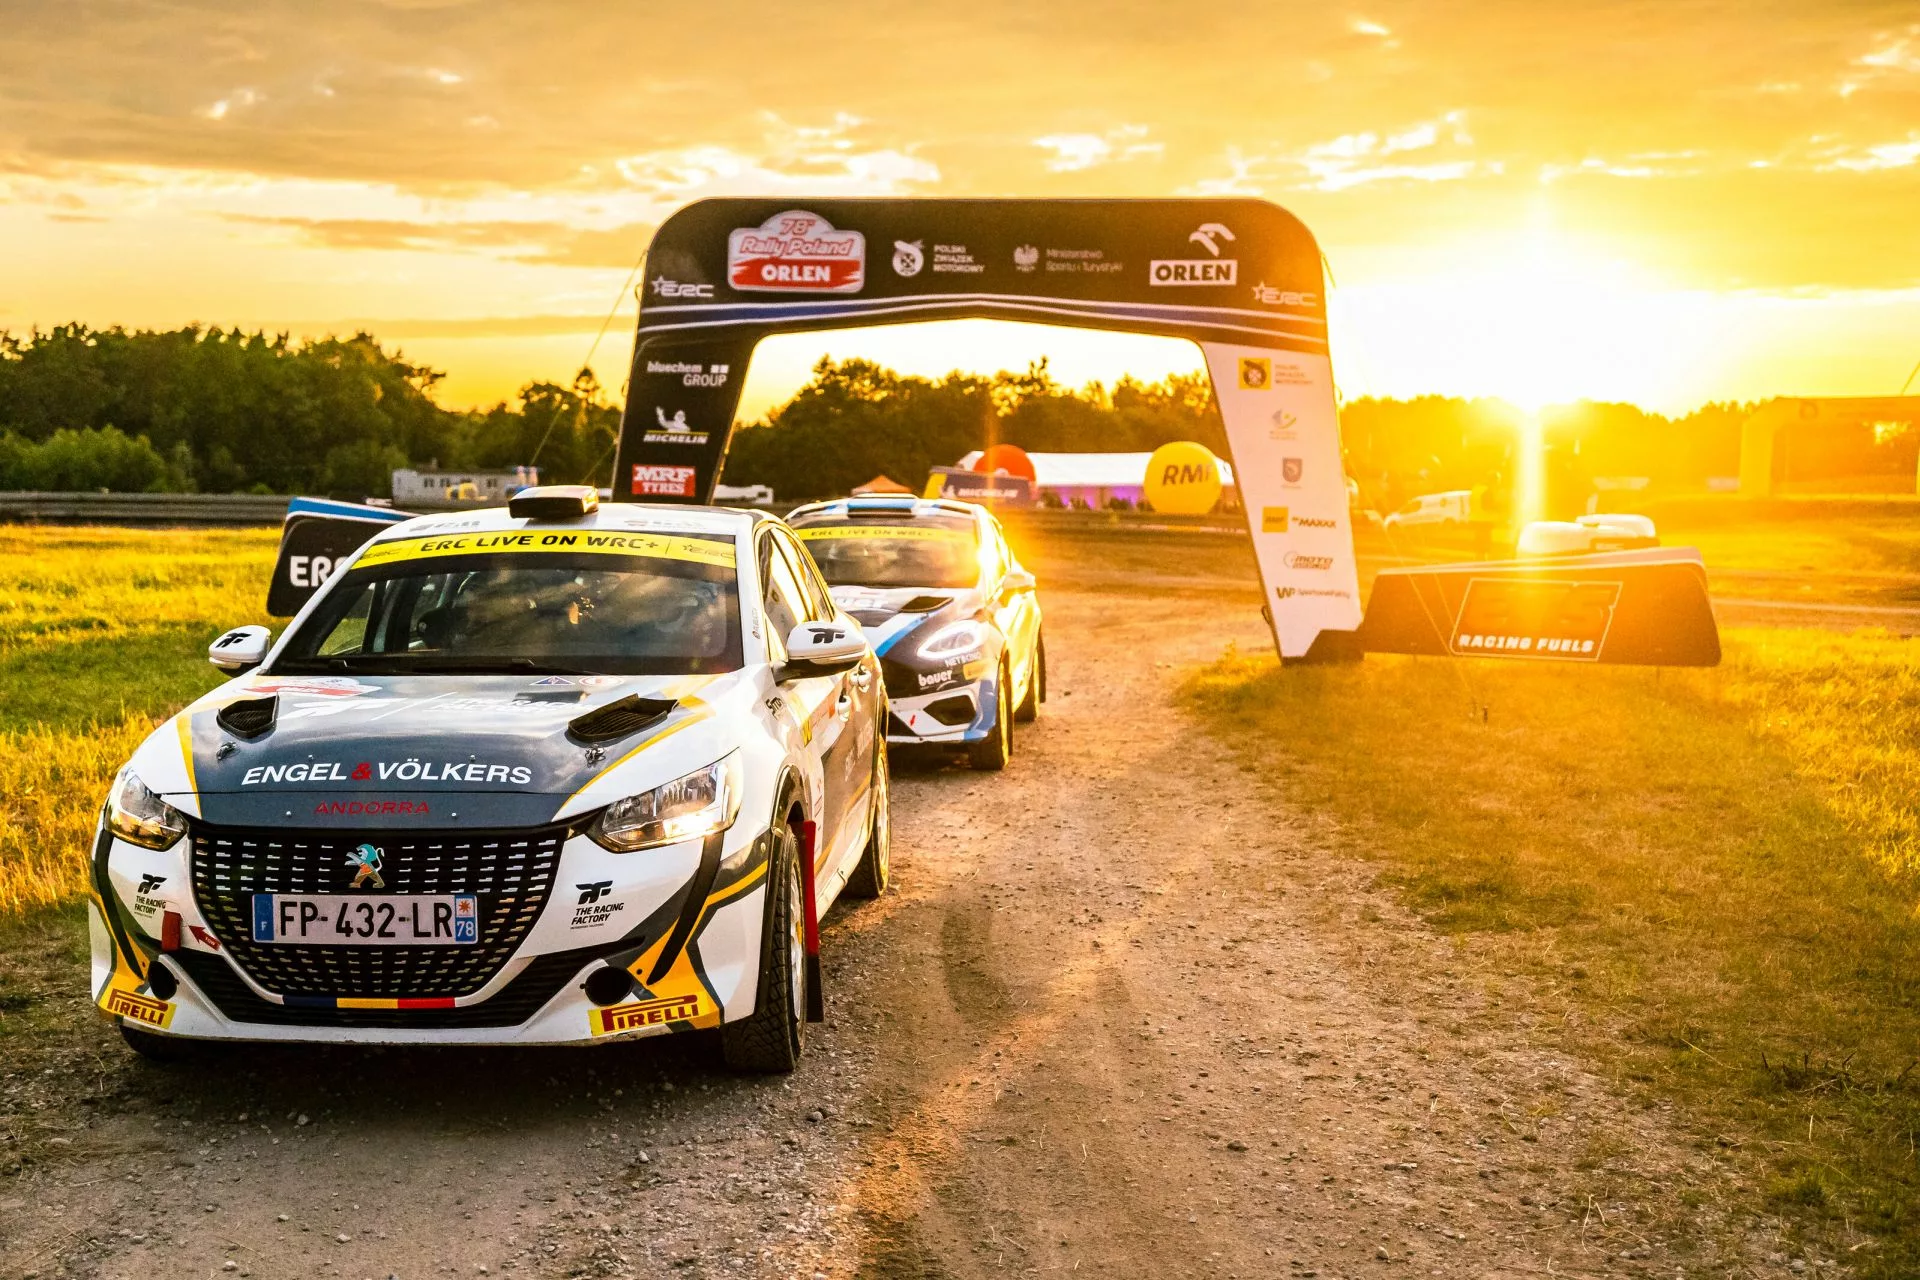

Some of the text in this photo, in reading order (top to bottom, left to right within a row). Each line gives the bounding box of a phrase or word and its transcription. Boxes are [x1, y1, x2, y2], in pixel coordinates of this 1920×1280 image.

[740, 237, 853, 257] Rally Poland
[933, 244, 966, 253] POLSKI
[761, 264, 831, 282] ORLEN
[933, 263, 985, 273] MOTOROWY
[1155, 264, 1231, 281] ORLEN
[647, 361, 702, 373] bluechem
[683, 374, 728, 387] GROUP
[643, 434, 708, 444] MICHELIN
[634, 466, 695, 482] MRF
[642, 482, 685, 493] TYRES
[421, 538, 469, 552] ERC
[476, 535, 534, 548] LIVE
[541, 535, 577, 546] ON
[587, 536, 658, 550] WRC+
[289, 555, 351, 588] ER
[1458, 634, 1595, 653] RACING FUELS
[918, 669, 953, 687] bauer
[241, 758, 533, 785] ENGEL & VÖLKERS
[315, 801, 430, 815] ANDORRA
[134, 904, 157, 915] FACTORY
[135, 895, 166, 909] THE RACING
[575, 902, 625, 916] THE RACING
[260, 901, 475, 938] F FP-432-LR 78
[571, 913, 611, 925] FACTORY
[106, 988, 168, 1025] PIRELLI
[600, 994, 699, 1032] PIRELLI
